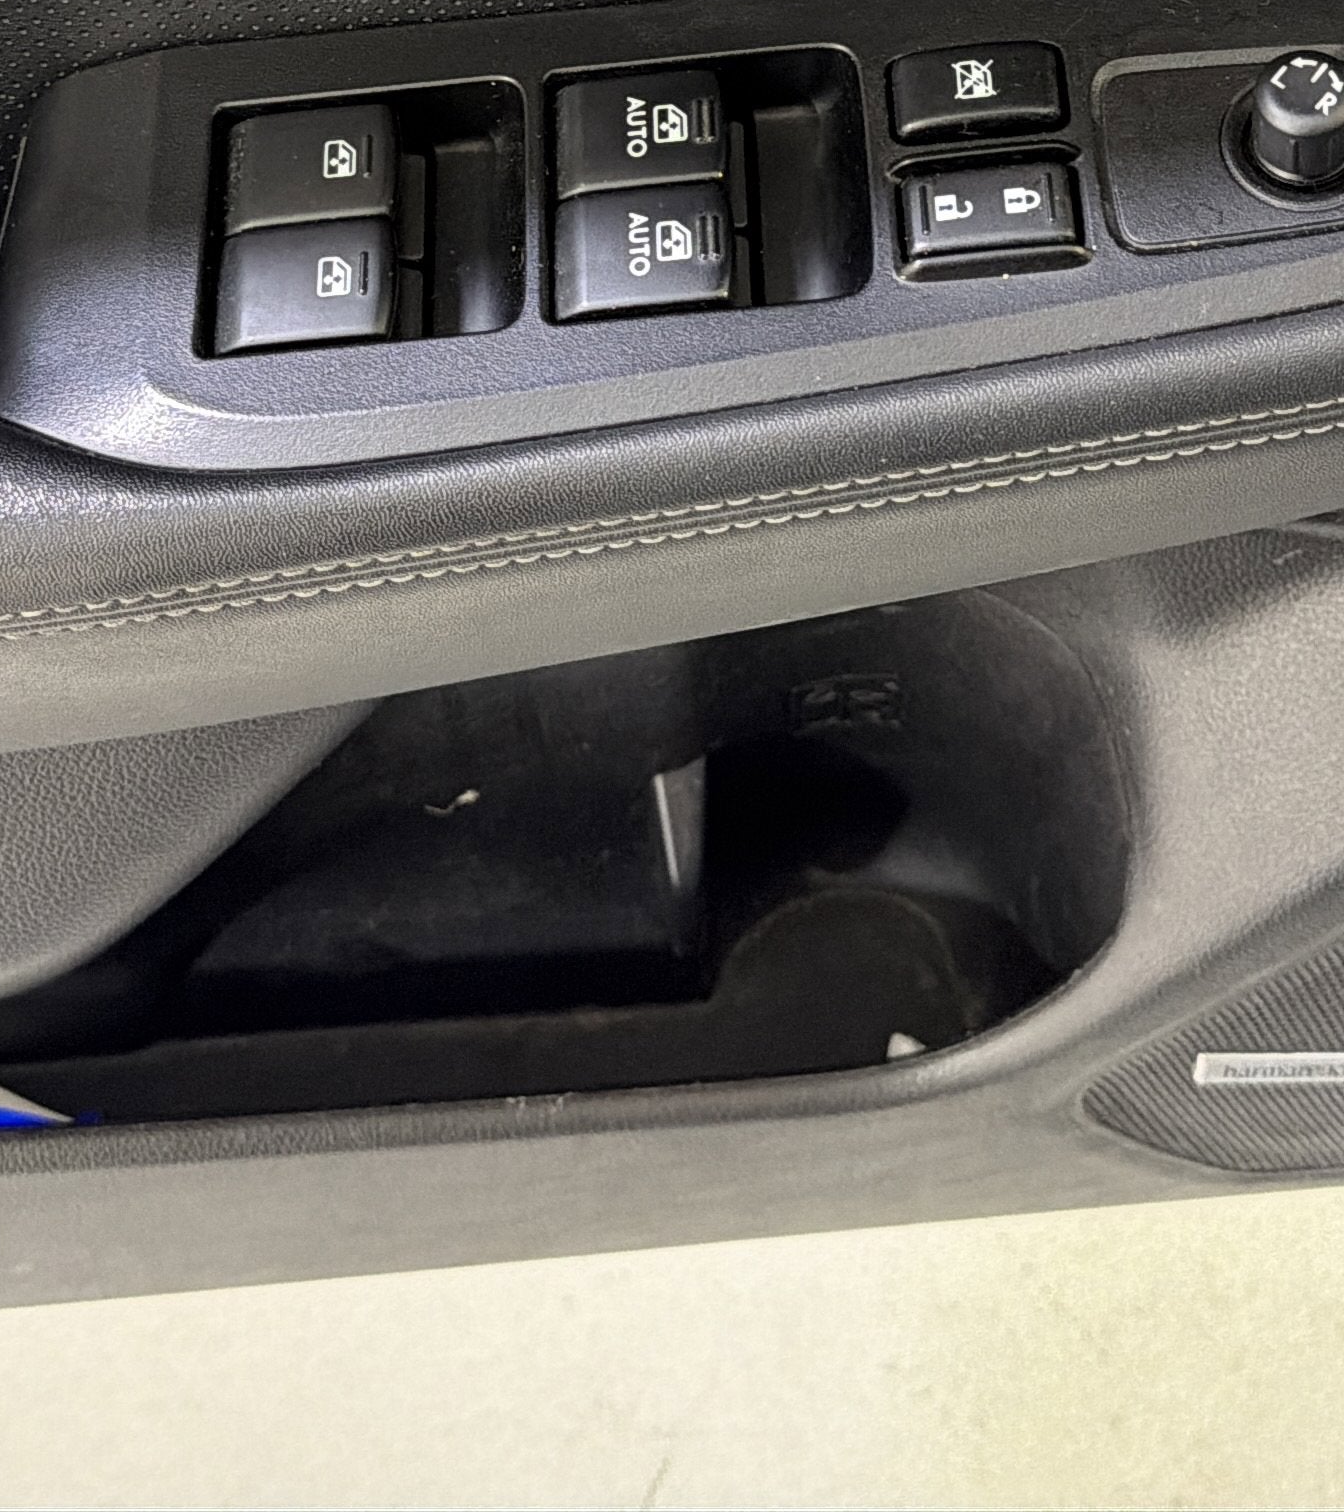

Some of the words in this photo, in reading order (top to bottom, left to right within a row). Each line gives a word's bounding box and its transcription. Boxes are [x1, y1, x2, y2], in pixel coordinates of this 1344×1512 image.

[1270, 65, 1288, 90] L
[1314, 91, 1338, 117] R
[626, 96, 648, 158] AUTO
[628, 212, 651, 277] AUTO
